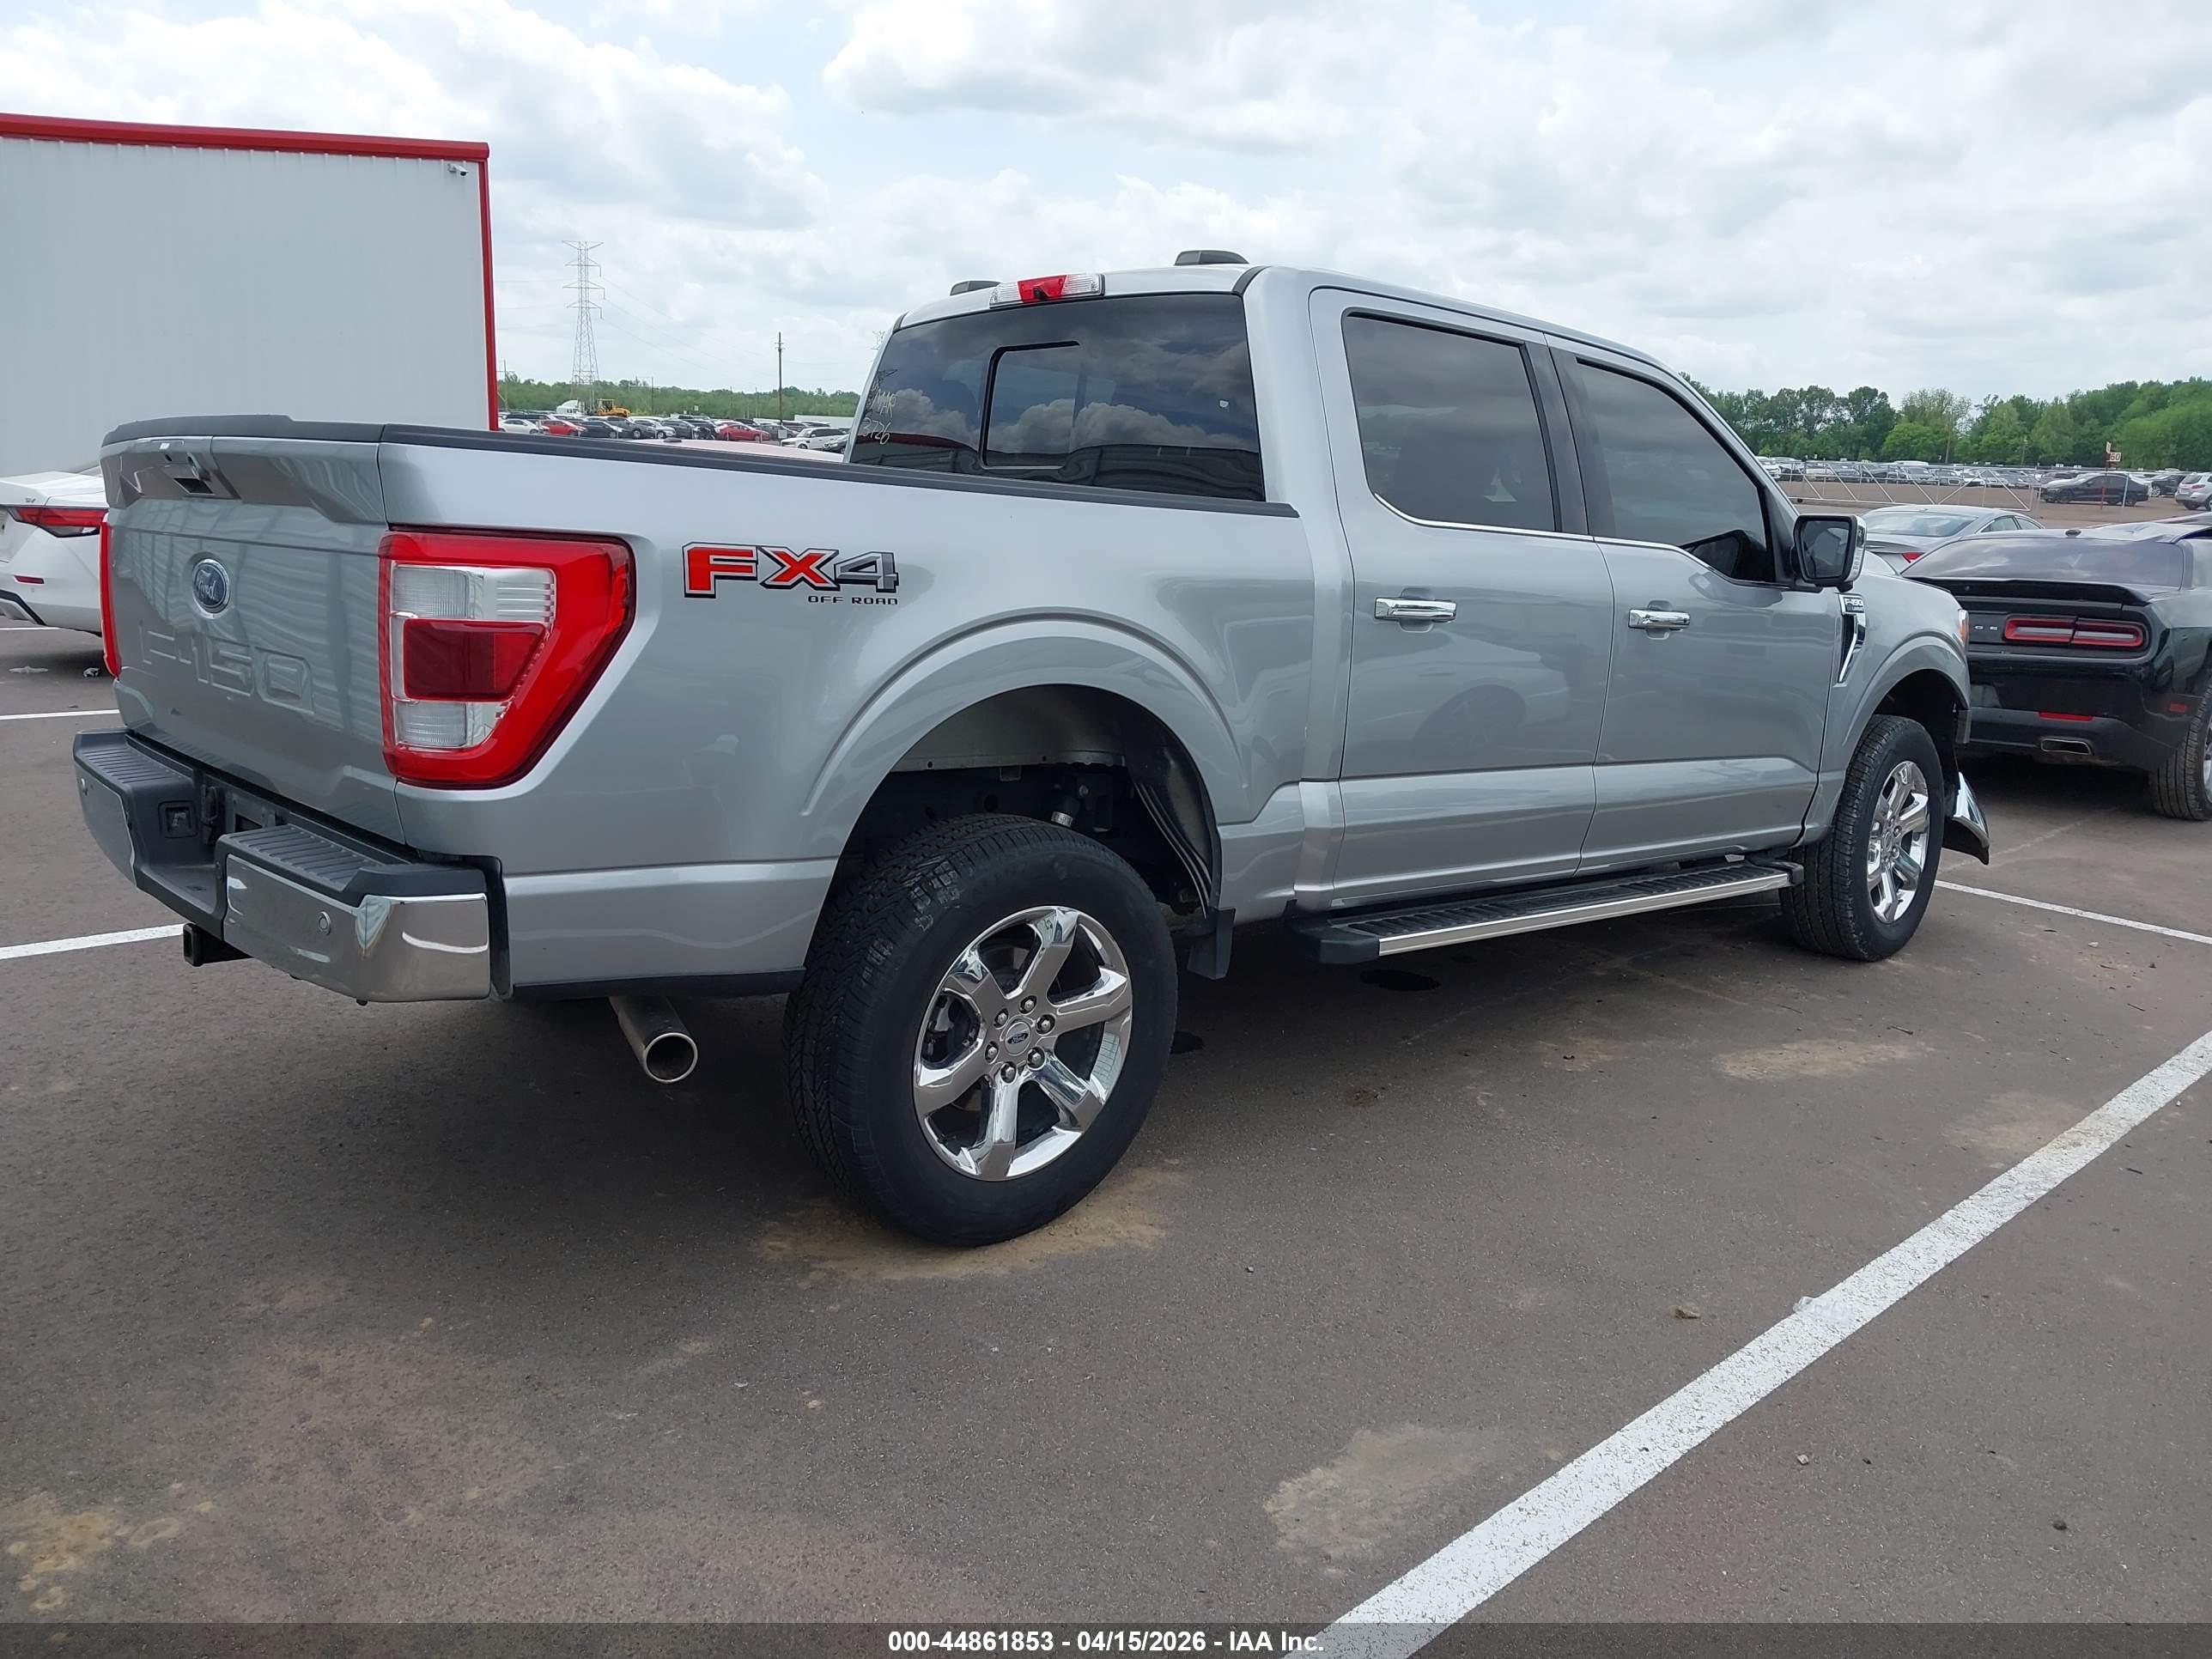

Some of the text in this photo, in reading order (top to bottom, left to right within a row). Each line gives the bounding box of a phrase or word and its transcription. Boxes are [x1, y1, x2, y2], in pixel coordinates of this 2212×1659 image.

[682, 541, 899, 599] FX4
[807, 595, 898, 605] OFF ROAD
